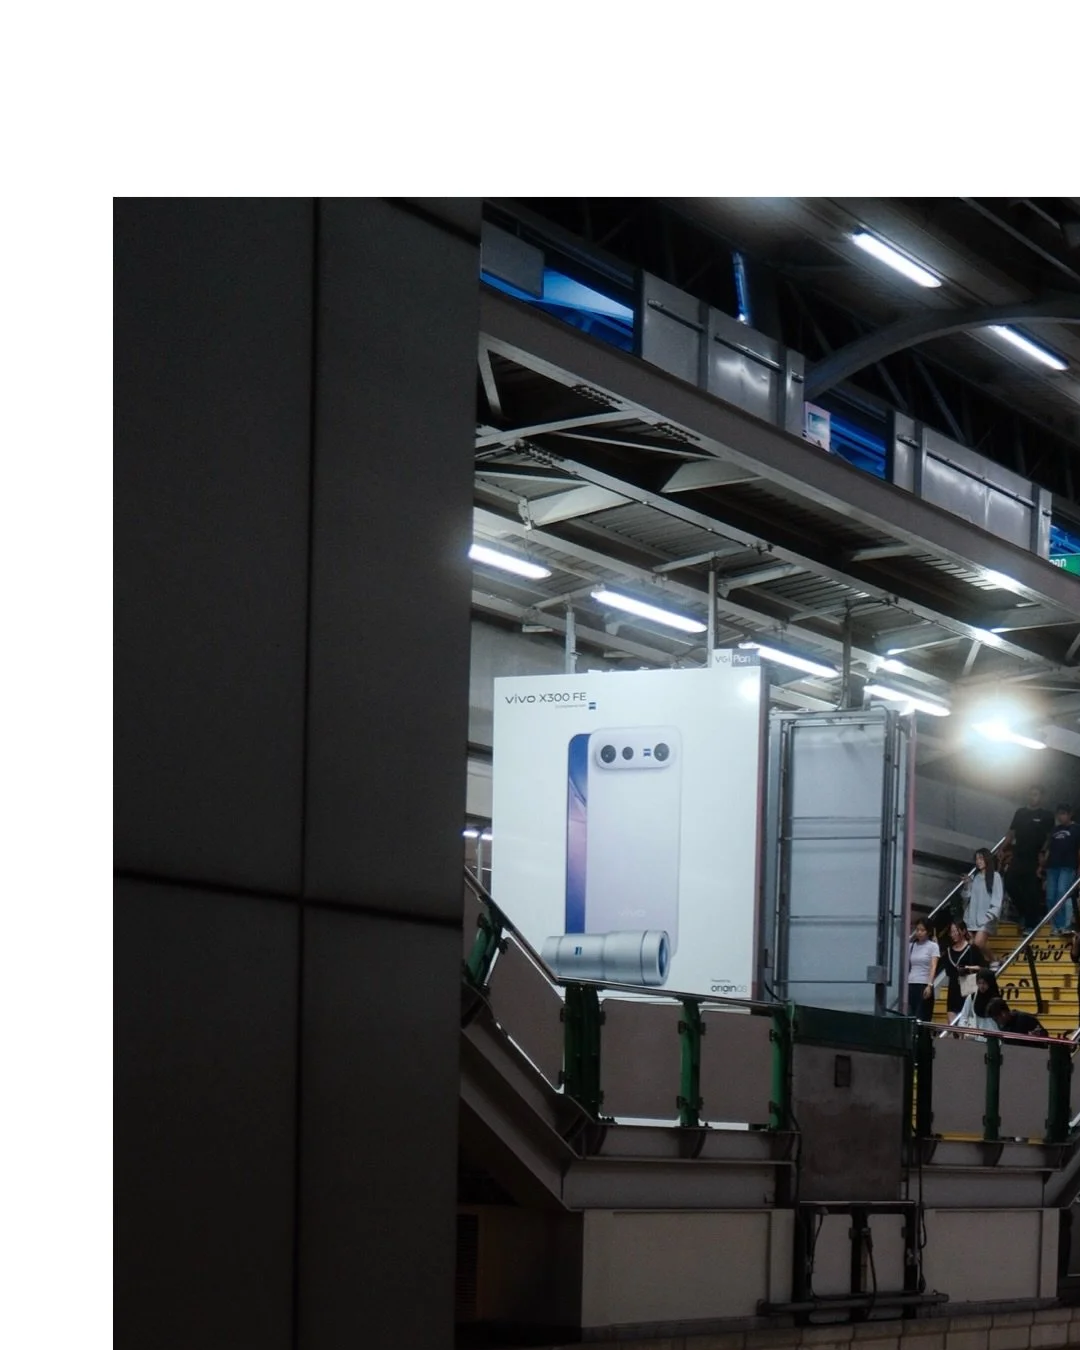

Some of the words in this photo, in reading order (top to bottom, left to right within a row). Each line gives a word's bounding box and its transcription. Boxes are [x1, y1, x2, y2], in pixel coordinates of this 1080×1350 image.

[504, 693, 536, 704] vivo
[539, 693, 570, 703] X300
[570, 692, 587, 701] FE
